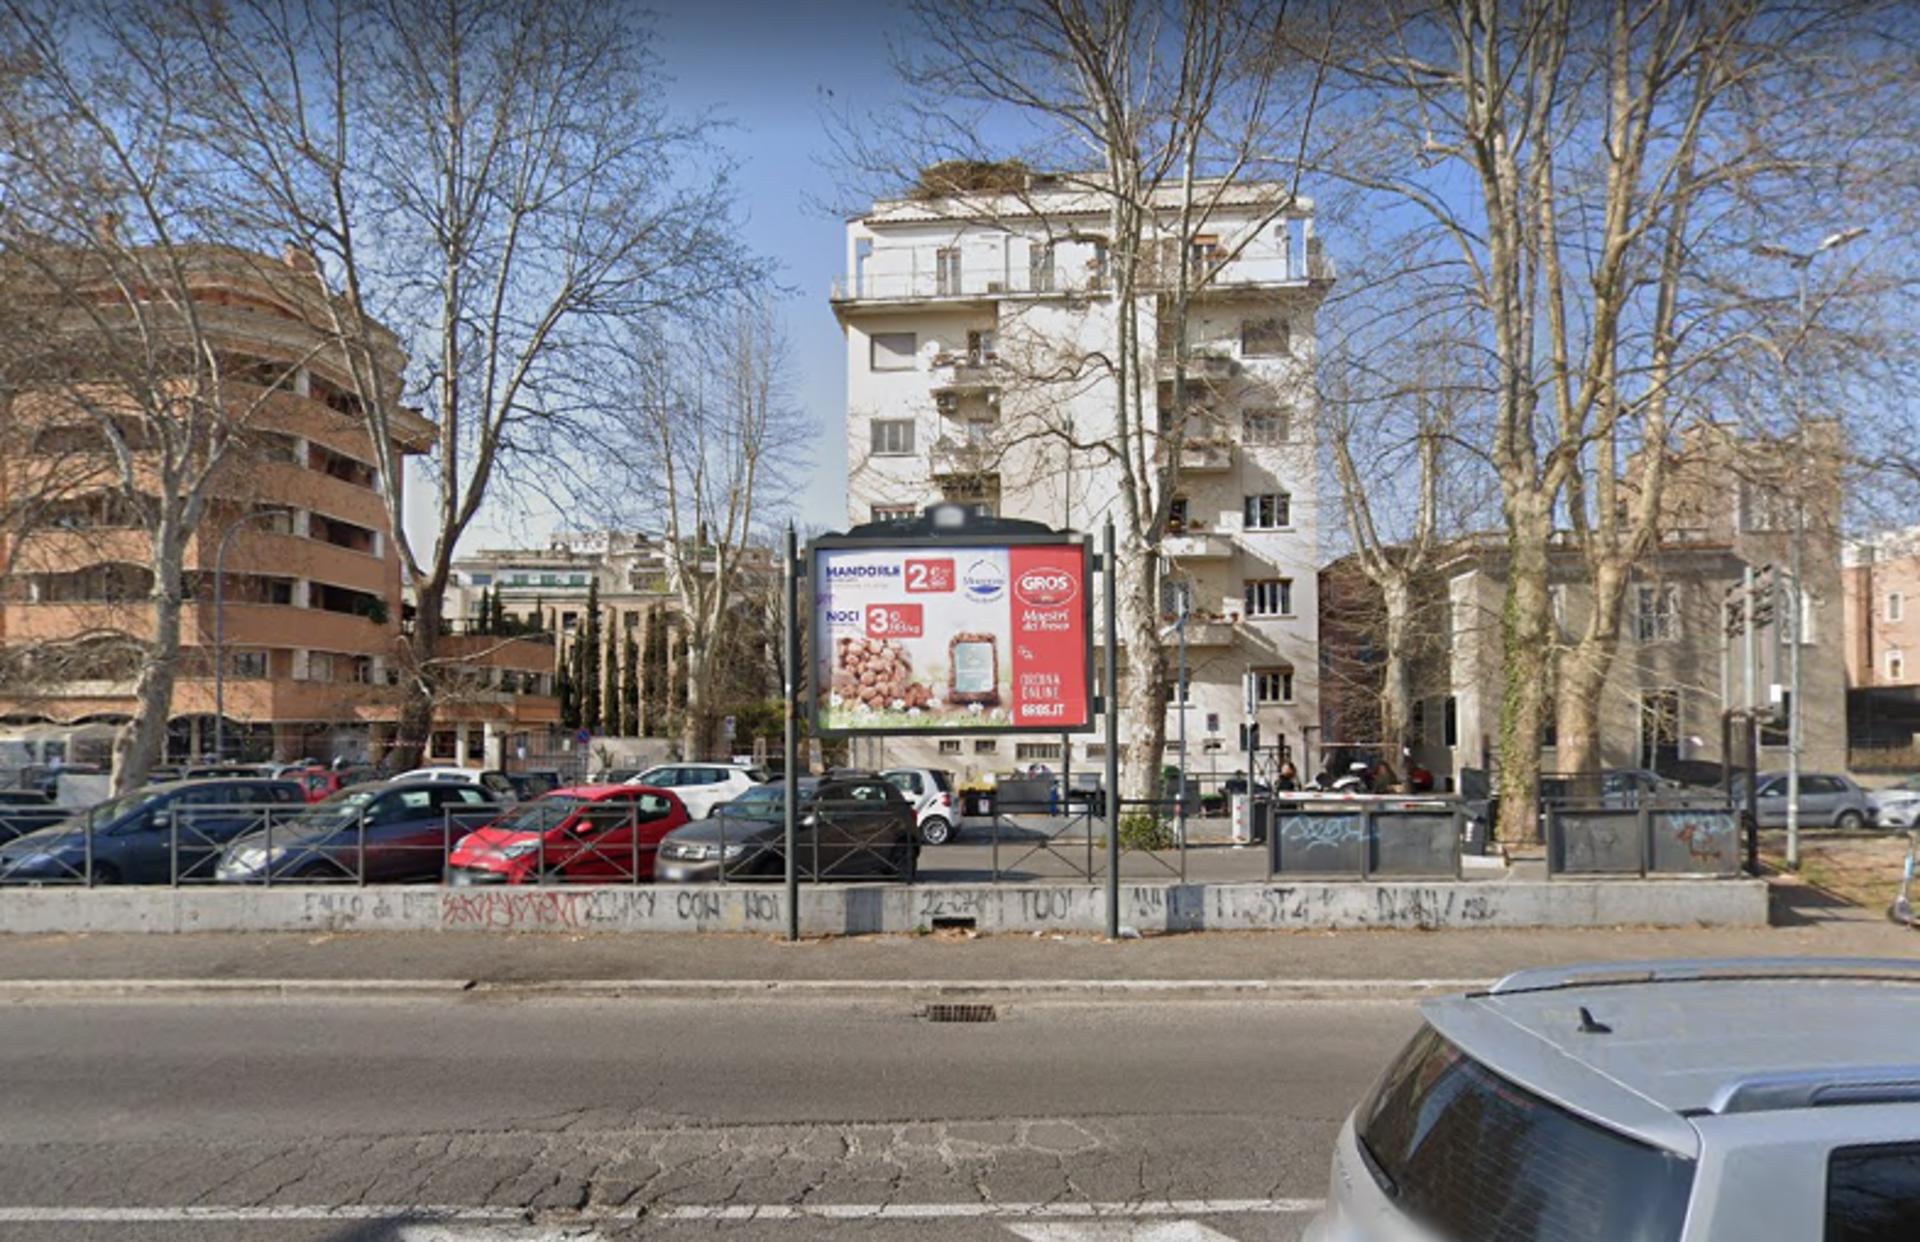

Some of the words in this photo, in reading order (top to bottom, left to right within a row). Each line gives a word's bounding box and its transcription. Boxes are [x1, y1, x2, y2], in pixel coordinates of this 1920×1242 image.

[1021, 576, 1069, 591] GROS
[826, 611, 860, 622] NOCI
[1022, 609, 1069, 621] Maestri
[1021, 686, 1059, 699] ONLINE
